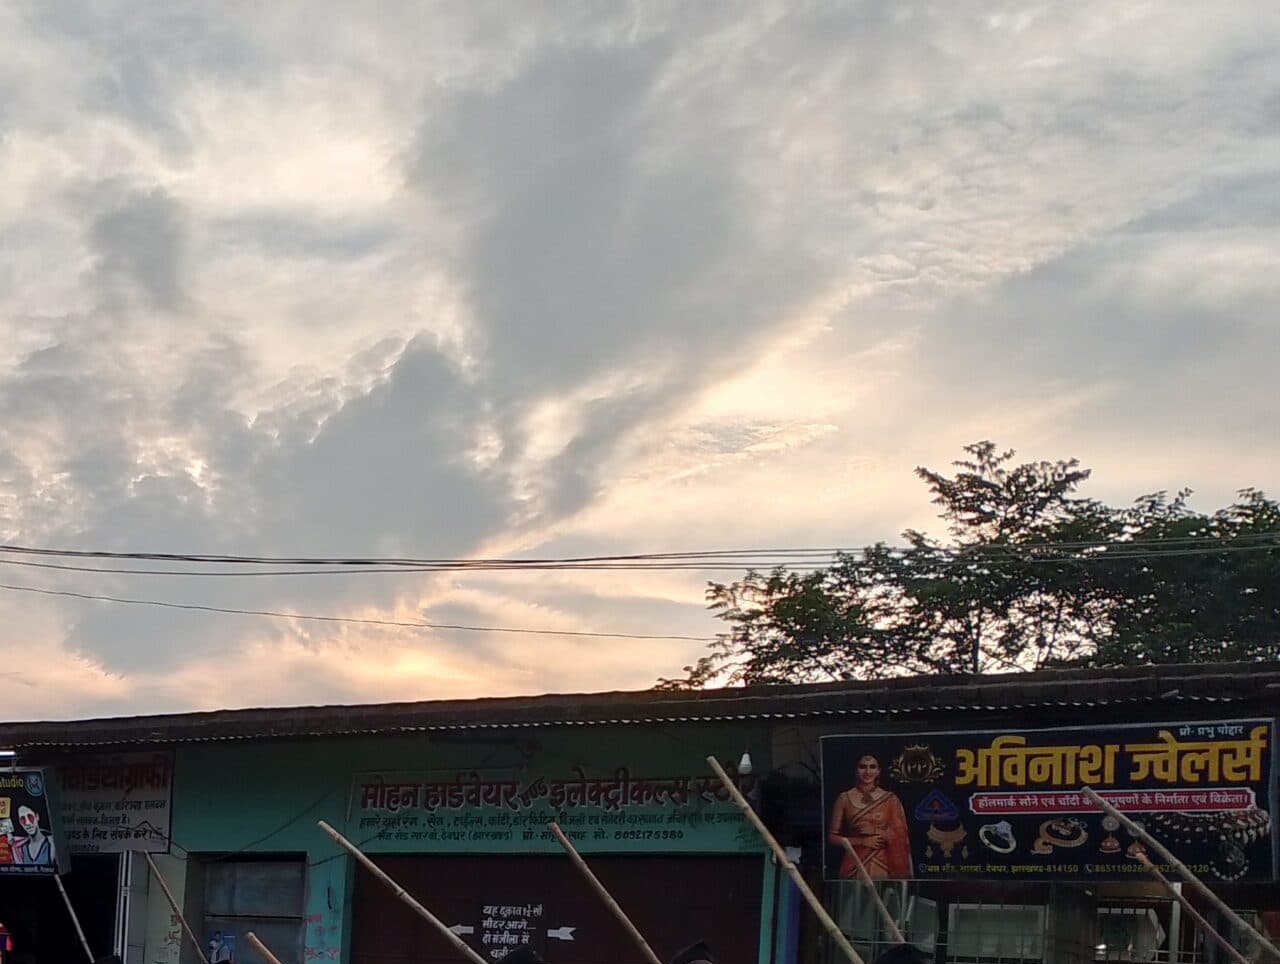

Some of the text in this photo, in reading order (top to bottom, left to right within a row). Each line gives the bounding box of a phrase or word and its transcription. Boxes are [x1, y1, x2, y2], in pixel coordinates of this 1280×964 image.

[955, 726, 1269, 787] अविनाश ज्वेलर्स
[361, 775, 421, 812] मोहन
[424, 771, 522, 812] हार्डवेयर
[978, 796, 1017, 809] हॉलमार्क
[1019, 795, 1038, 807] सोने
[1141, 793, 1153, 805] के
[1154, 792, 1188, 804] निर्माता
